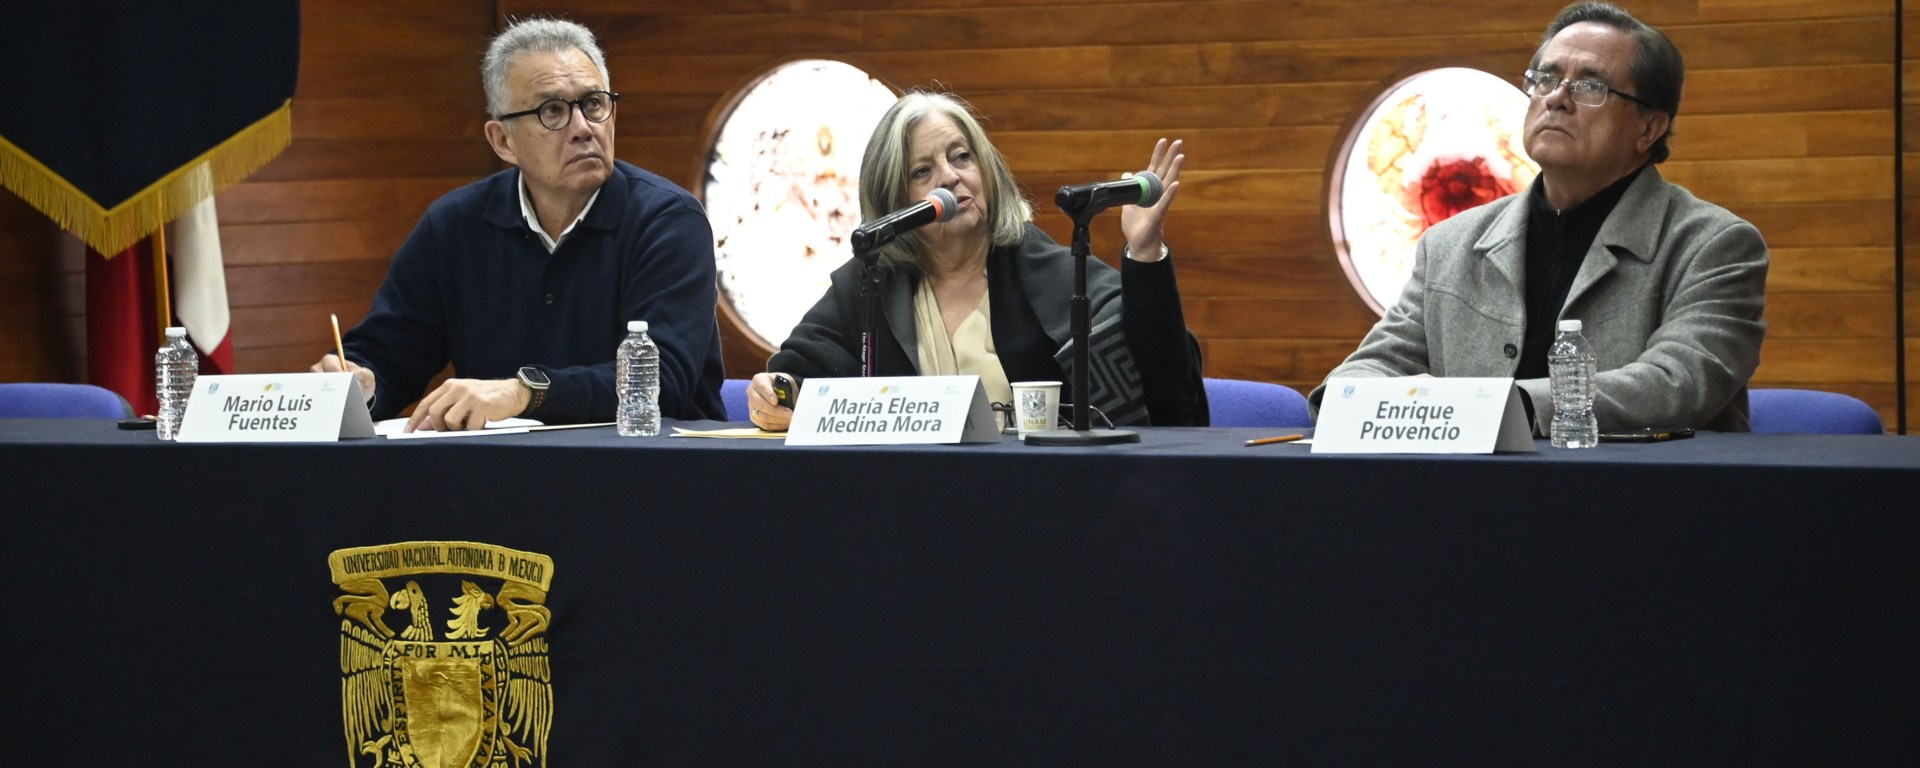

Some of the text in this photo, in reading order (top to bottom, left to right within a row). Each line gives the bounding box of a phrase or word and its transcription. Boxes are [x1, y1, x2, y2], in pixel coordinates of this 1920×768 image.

[223, 394, 312, 412] Mario Luis
[829, 397, 939, 414] María Elena
[1376, 400, 1454, 424] Enrique
[228, 413, 297, 430] Fuentes
[816, 415, 942, 433] Medina Mora
[1360, 421, 1460, 440] Provencio
[343, 550, 400, 574] UNIVERSIDAD
[402, 547, 444, 567] NACIONAL
[447, 547, 494, 570] AUTONOMA
[508, 556, 544, 583] MEXICO
[403, 644, 480, 659] POR MI
[480, 651, 496, 722] RAZA
